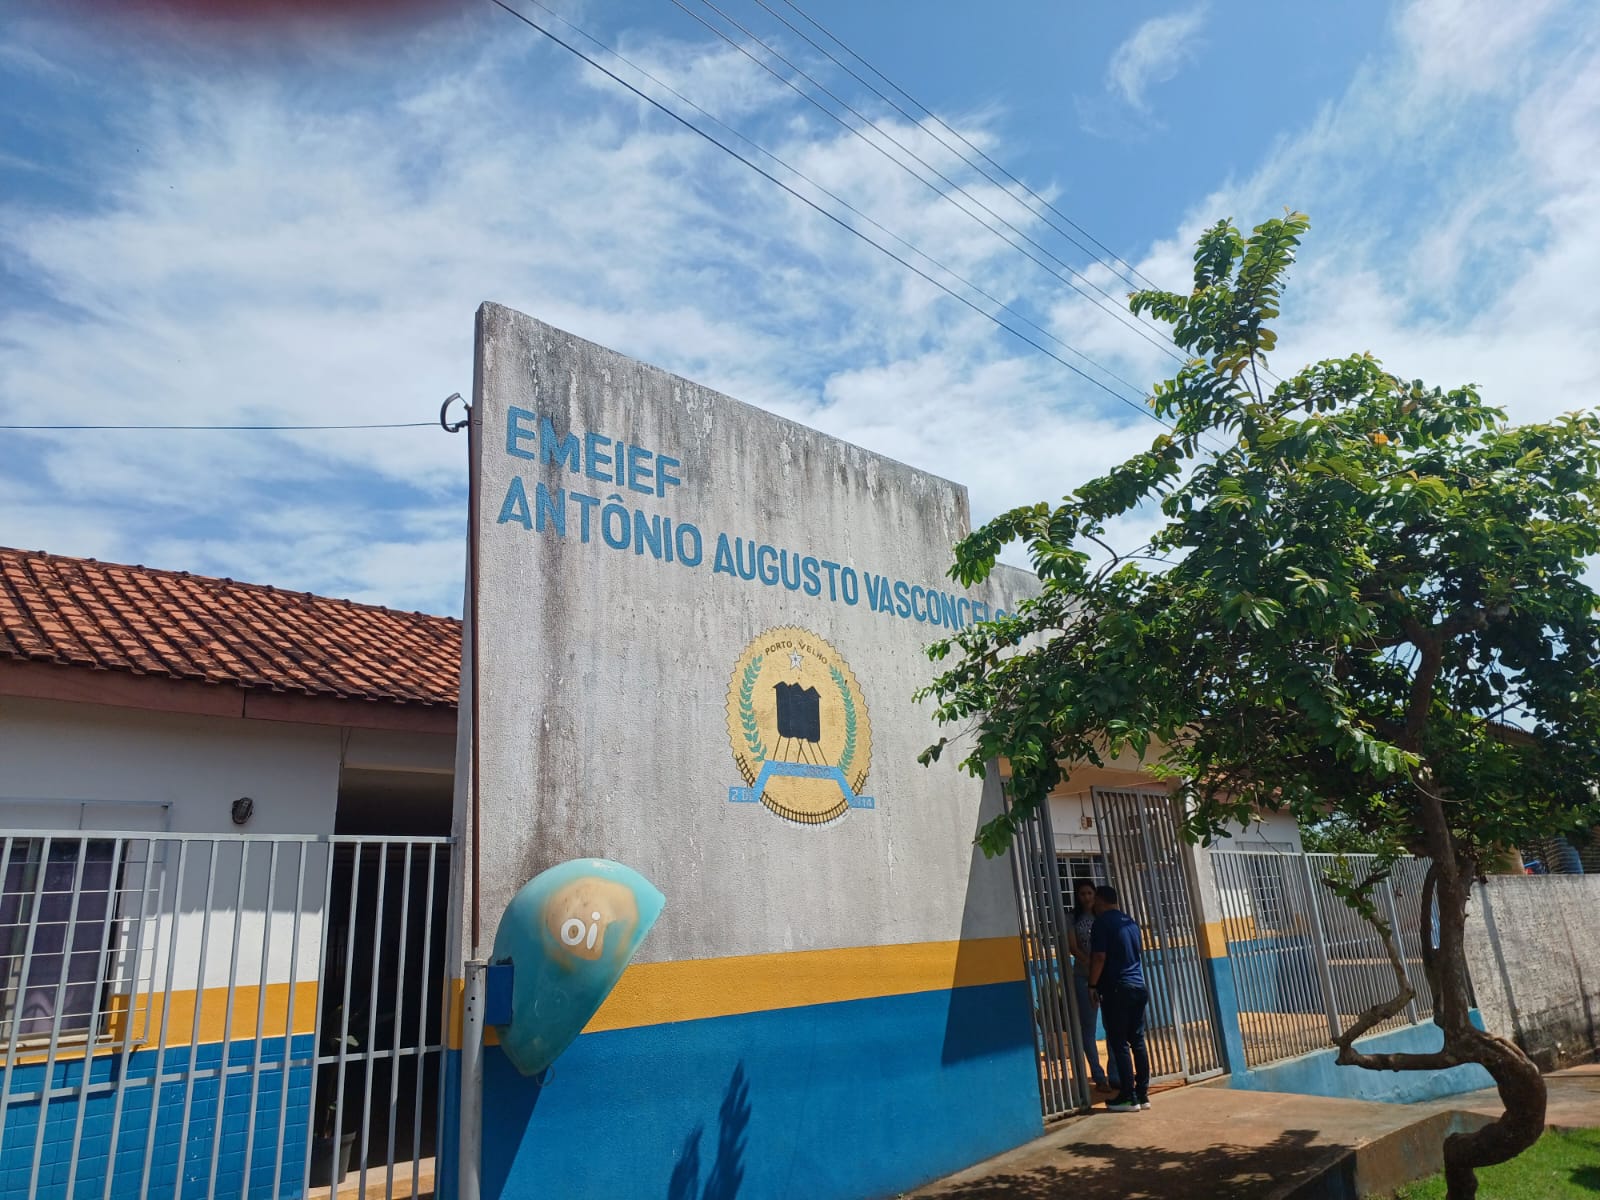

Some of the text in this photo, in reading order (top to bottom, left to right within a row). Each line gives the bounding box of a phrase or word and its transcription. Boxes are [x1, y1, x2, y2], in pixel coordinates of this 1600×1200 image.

[506, 405, 681, 498] EMEIEF
[497, 475, 1021, 644] ANTÔNIO AUGUSTO VASCONCE
[765, 640, 828, 665] PORTO VELHO
